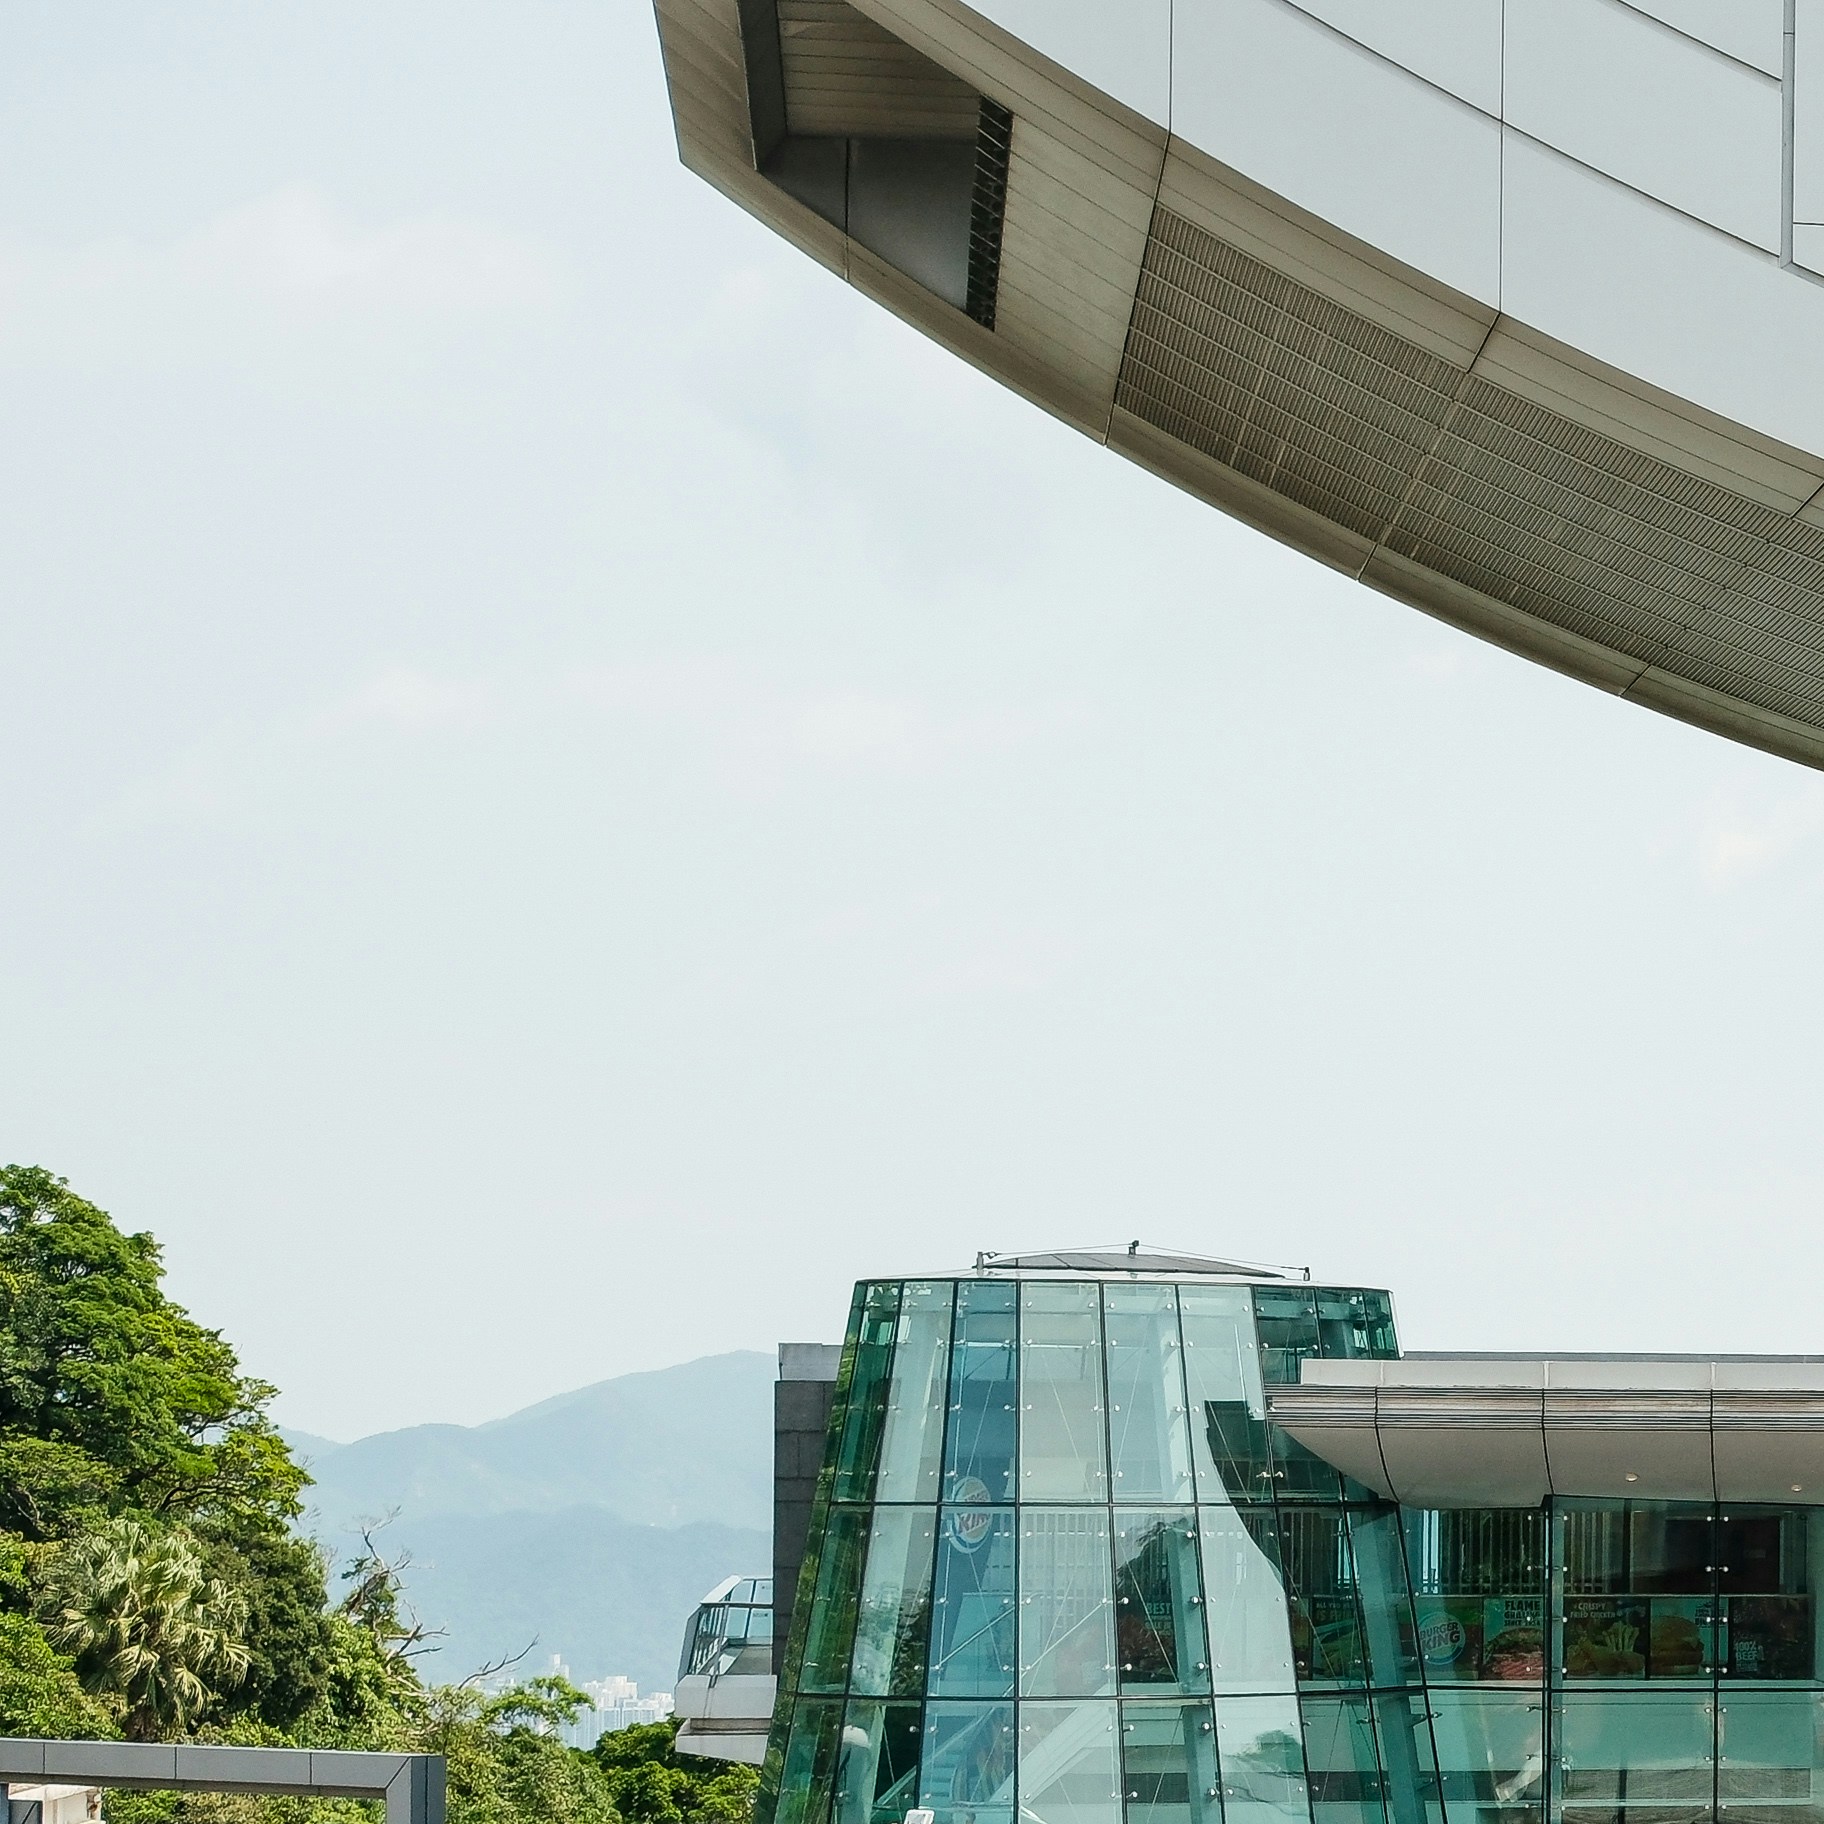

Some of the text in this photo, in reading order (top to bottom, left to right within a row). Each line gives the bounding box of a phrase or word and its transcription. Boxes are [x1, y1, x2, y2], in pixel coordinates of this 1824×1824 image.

[1504, 1600, 1541, 1611] FLAME
[1420, 1622, 1459, 1641] BURGER
[1421, 1630, 1461, 1651] KING
